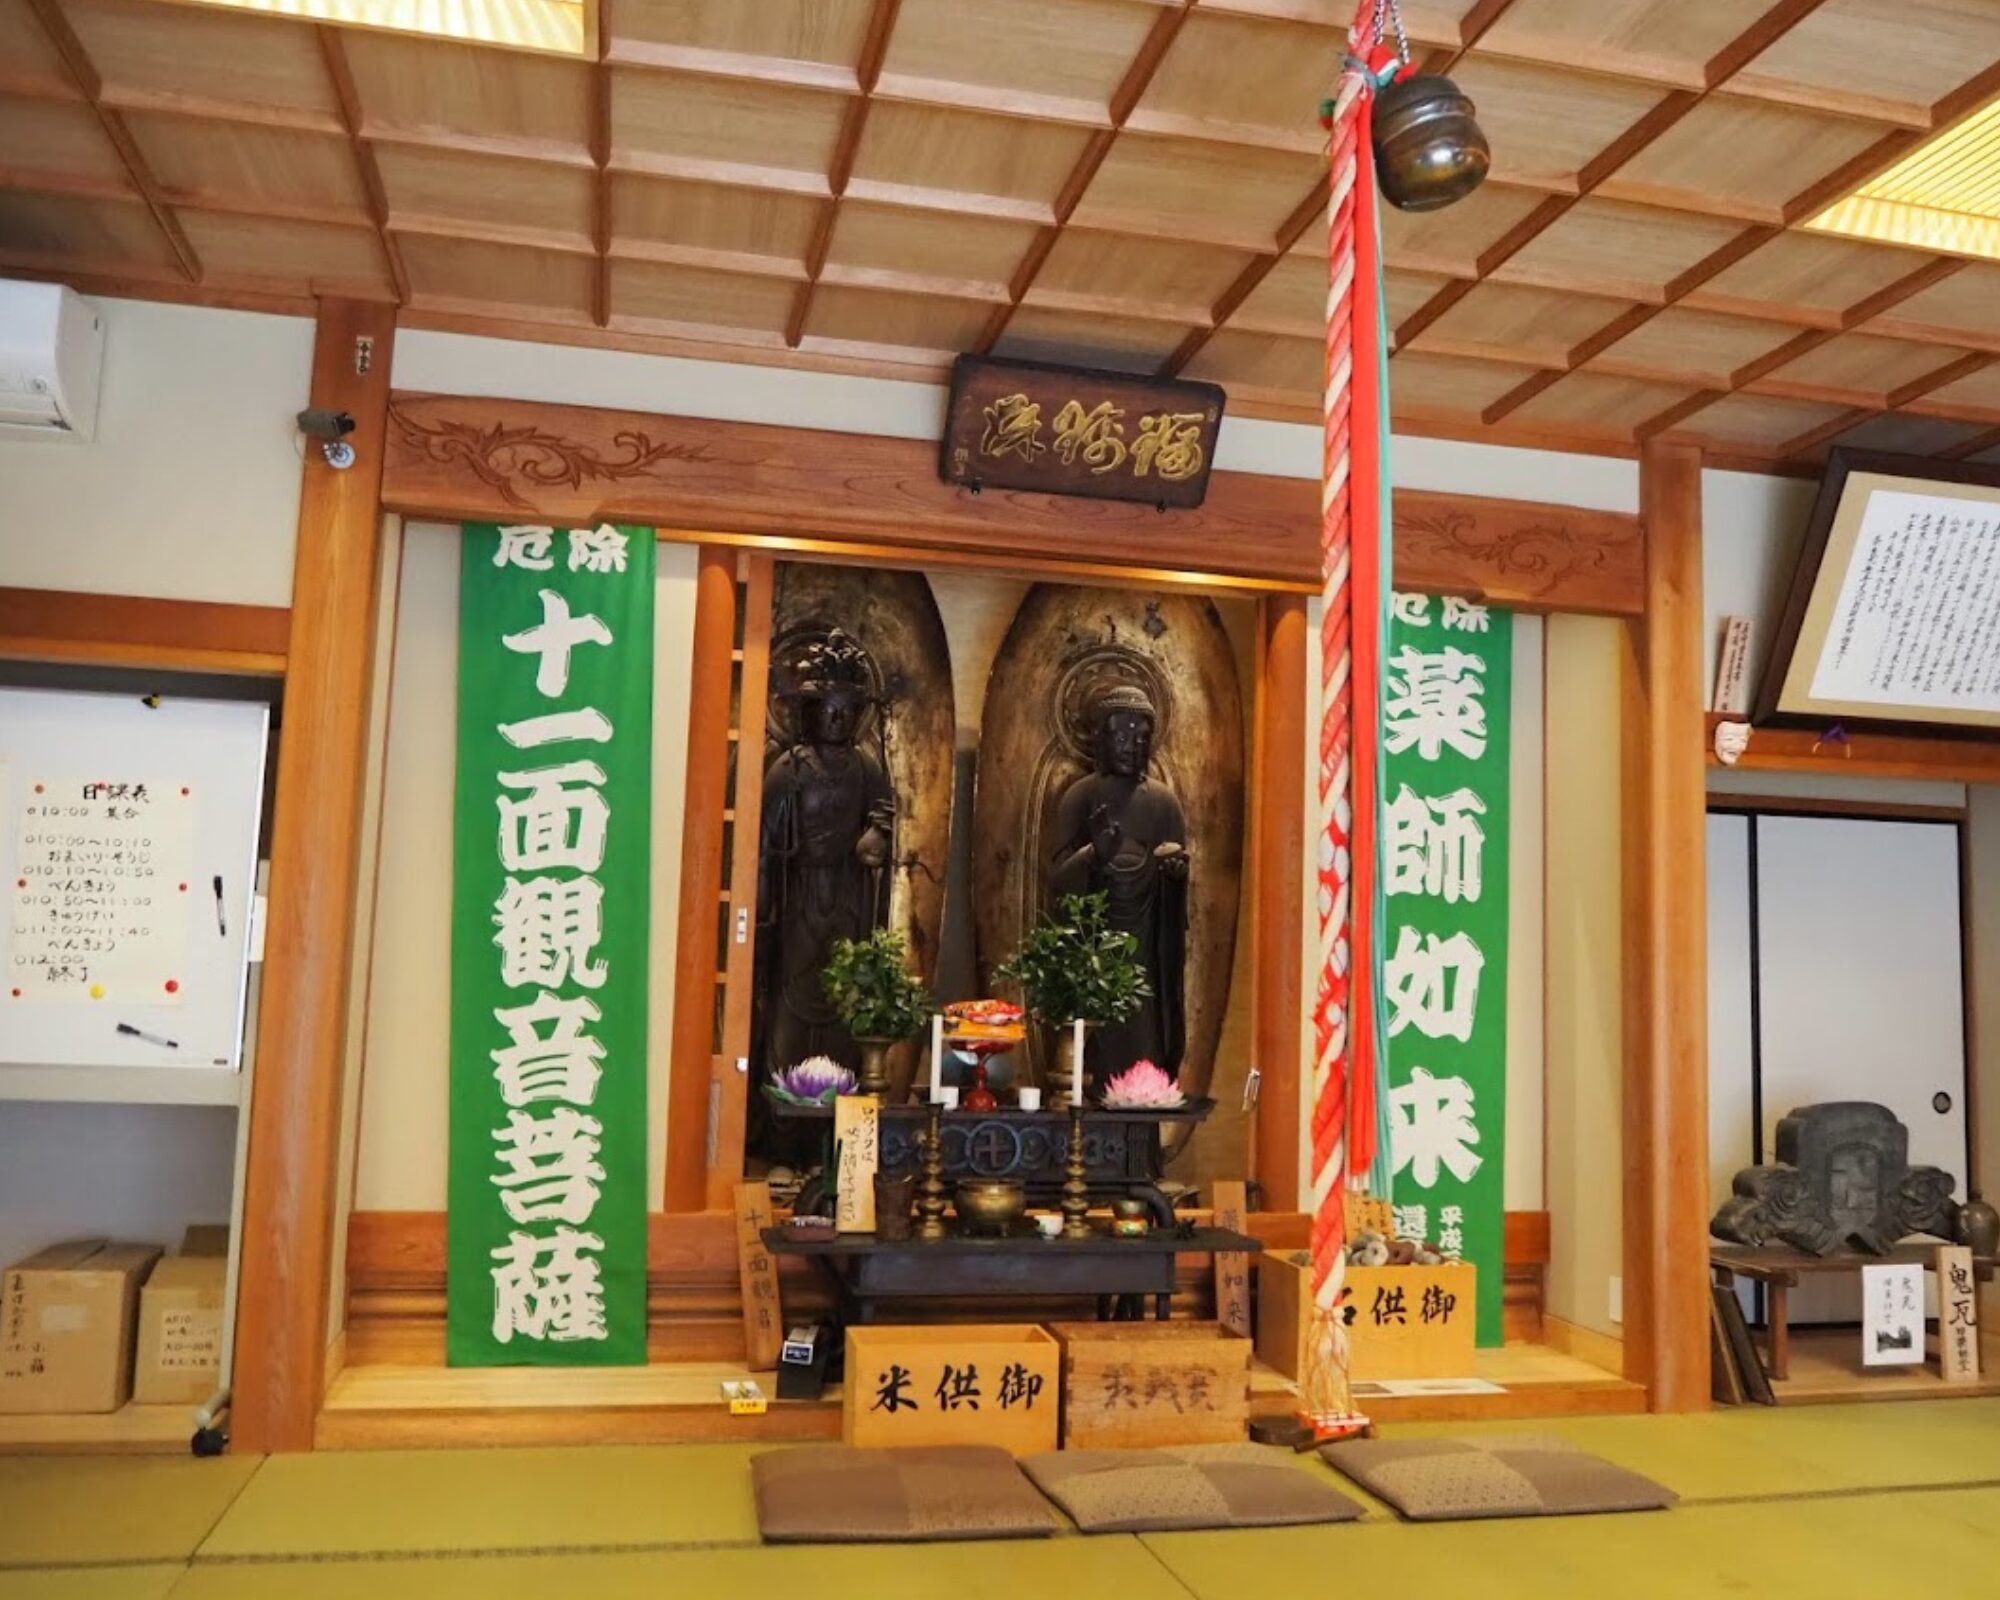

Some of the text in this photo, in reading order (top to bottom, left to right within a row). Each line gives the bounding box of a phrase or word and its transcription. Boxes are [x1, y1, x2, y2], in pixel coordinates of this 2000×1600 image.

[493, 523, 629, 572] 厄除
[1384, 644, 1487, 1188] 薬師如来
[489, 588, 614, 1343] 十一面観音菩薩
[1438, 1205, 1465, 1257] 平成
[1949, 1262, 1977, 1326] 鬼瓦
